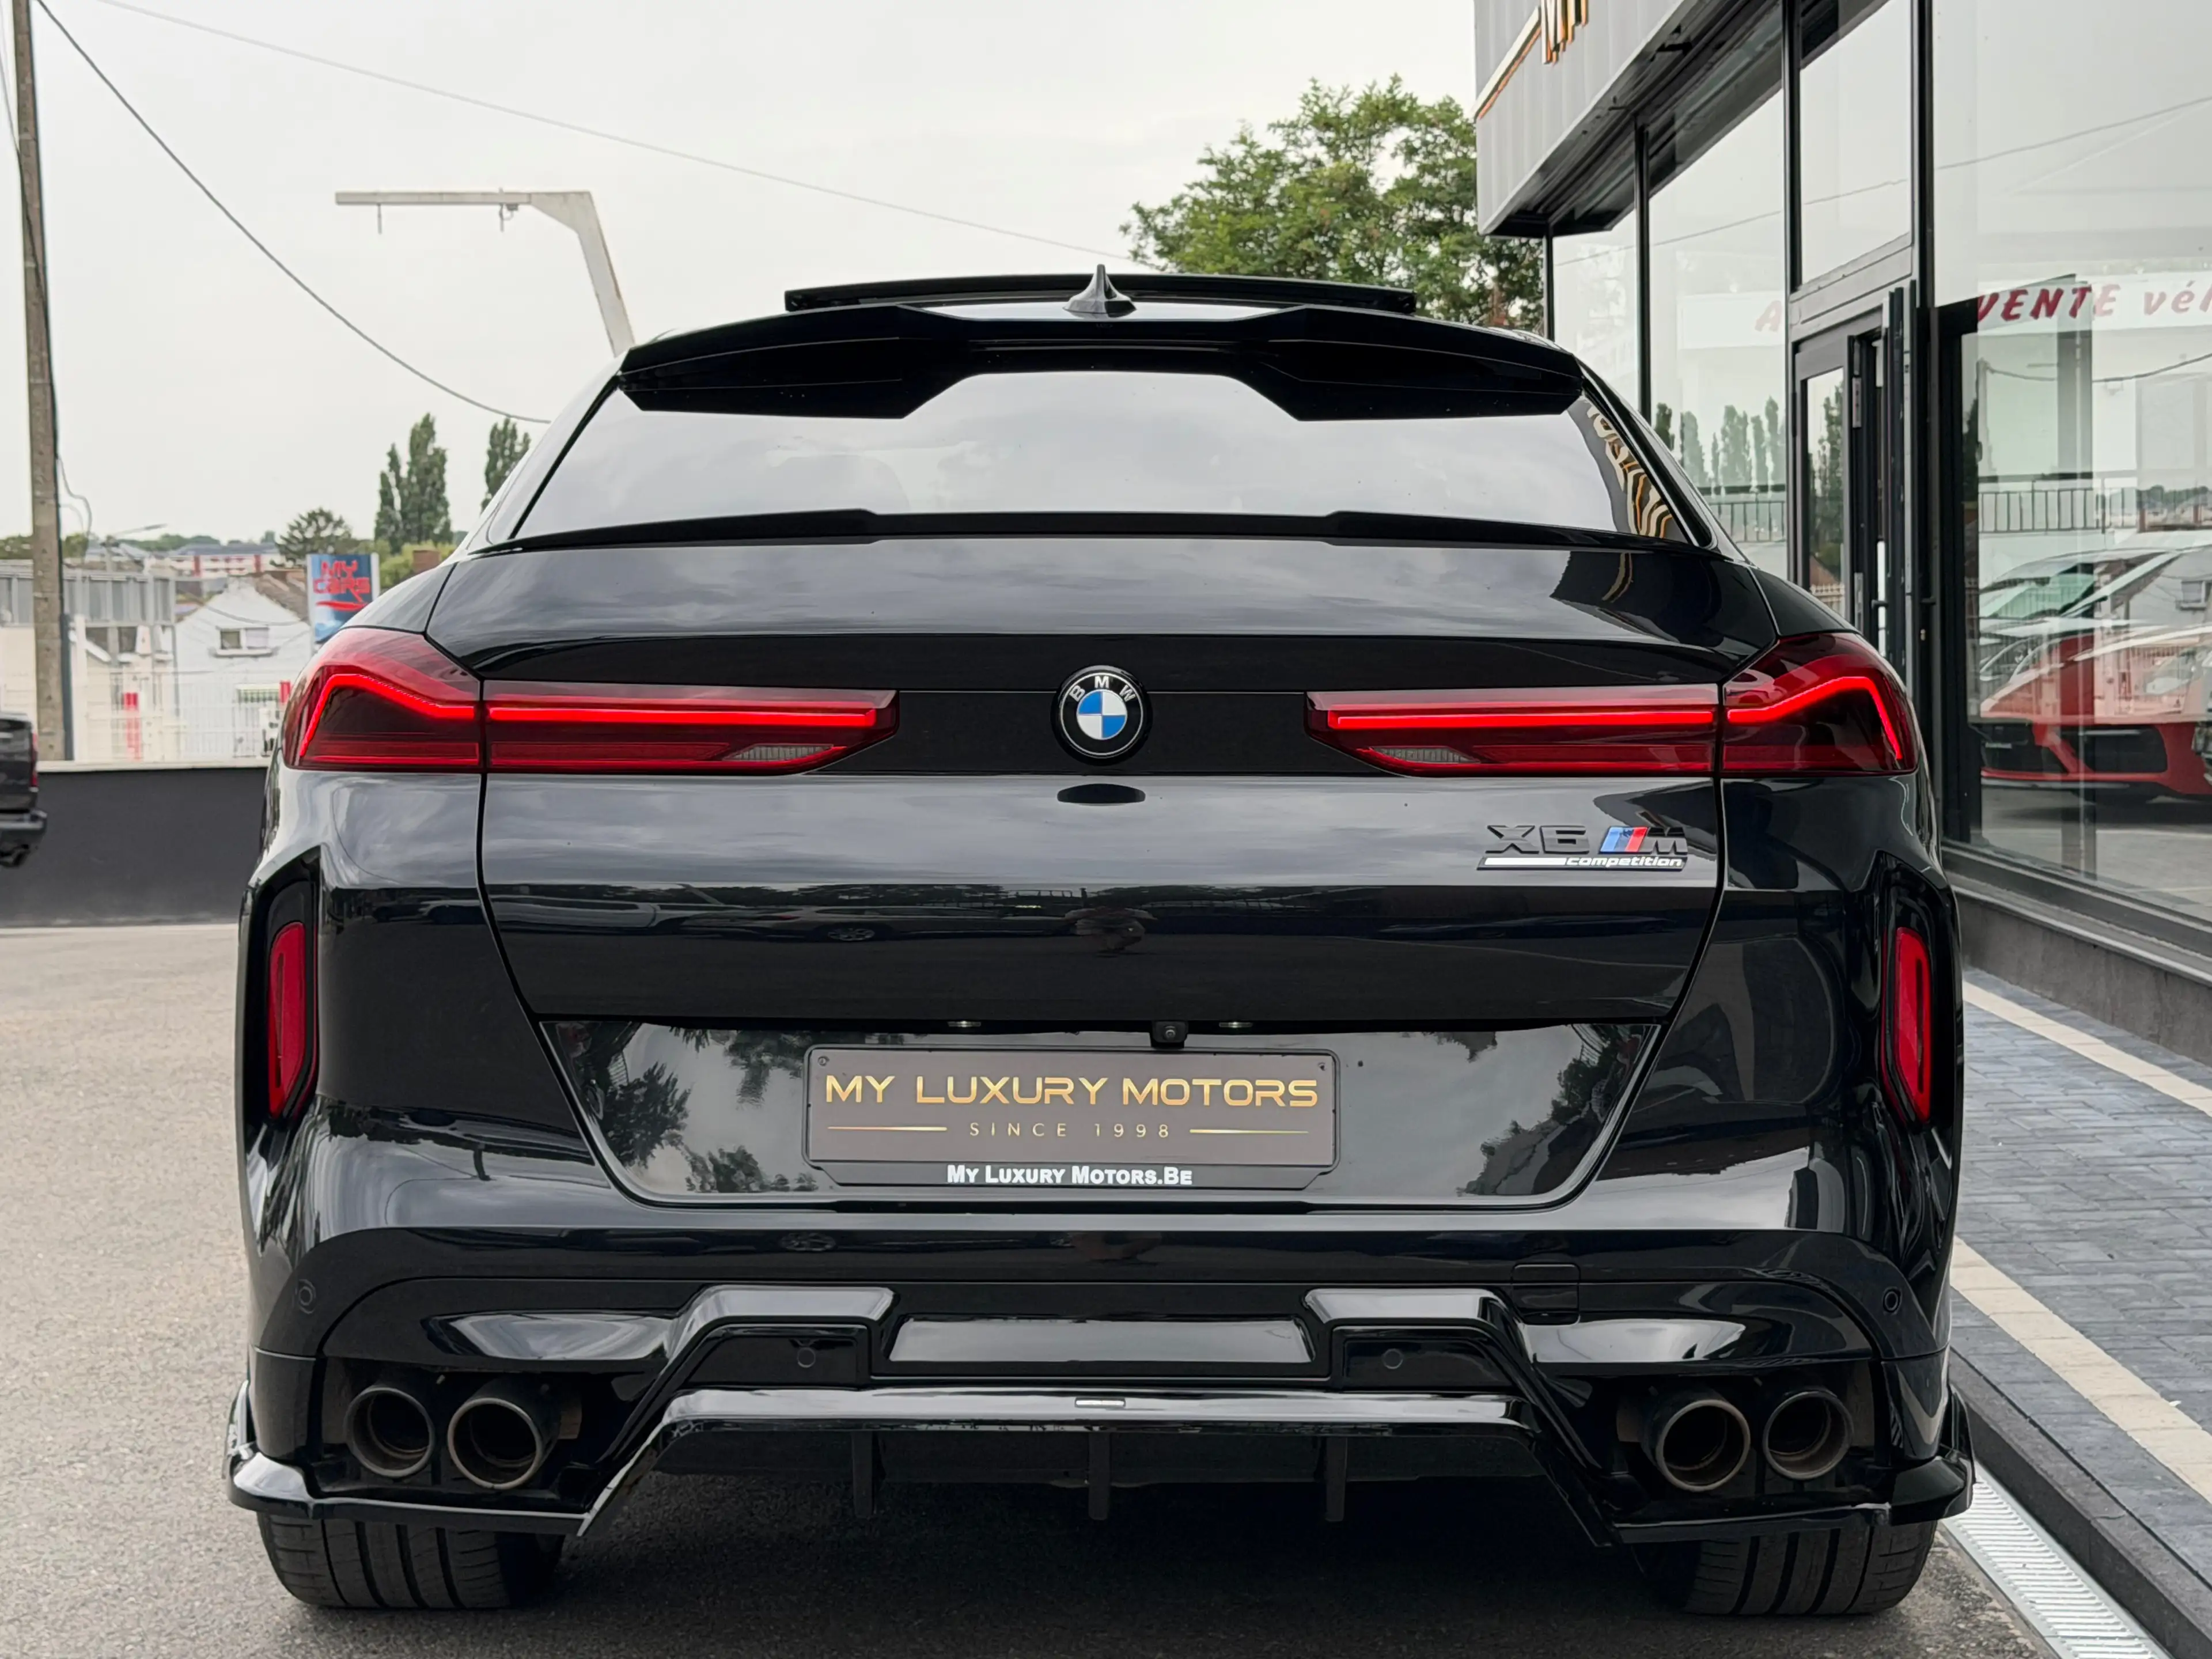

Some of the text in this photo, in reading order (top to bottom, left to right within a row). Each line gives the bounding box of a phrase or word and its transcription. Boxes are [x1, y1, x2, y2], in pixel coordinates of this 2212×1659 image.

[1978, 284, 2121, 322] VENTE
[1069, 676, 1136, 702] BMW
[1485, 825, 1590, 854] X6
[1566, 855, 1683, 868] competition
[825, 1075, 1318, 1107] MY LUXURY MOTORS
[969, 1122, 1169, 1138] SINCE 1998
